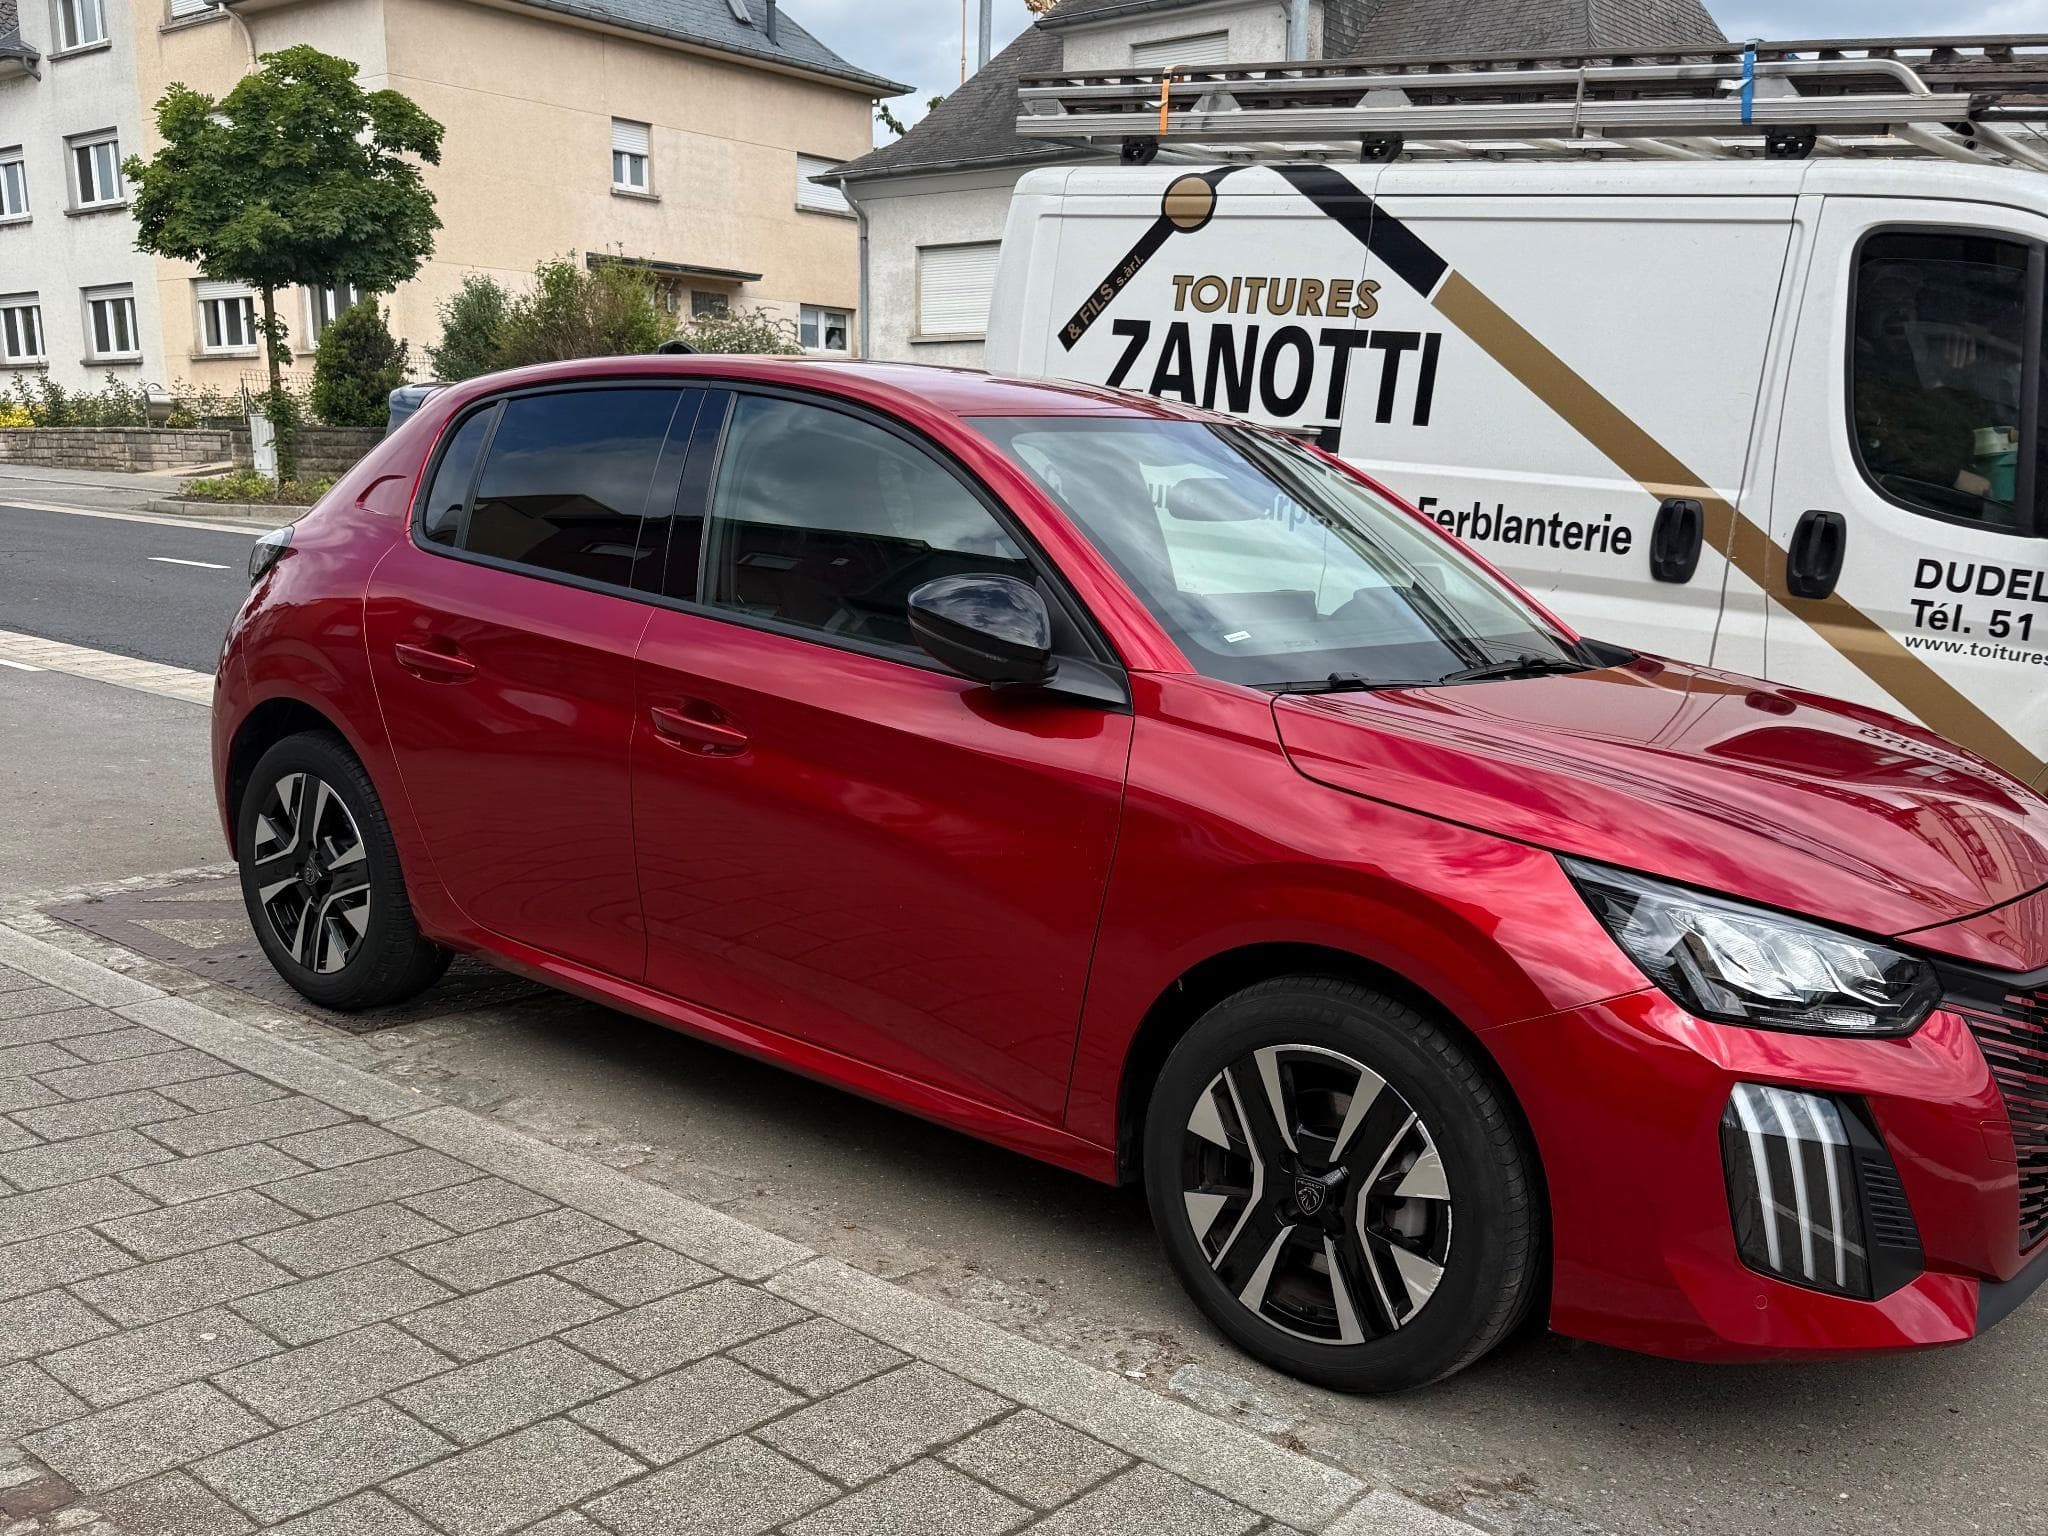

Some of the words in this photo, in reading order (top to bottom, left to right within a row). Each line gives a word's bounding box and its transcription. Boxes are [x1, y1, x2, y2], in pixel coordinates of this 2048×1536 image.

[1067, 323, 1082, 340] &
[1079, 283, 1114, 325] FILS
[1172, 274, 1381, 319] TOITURES
[1105, 318, 1442, 427] ZANOTTI
[1418, 496, 1632, 555] Ferblanterie
[1914, 558, 2048, 603] DUDEL
[1910, 598, 1971, 634] Tél.
[1988, 609, 2034, 641] 51
